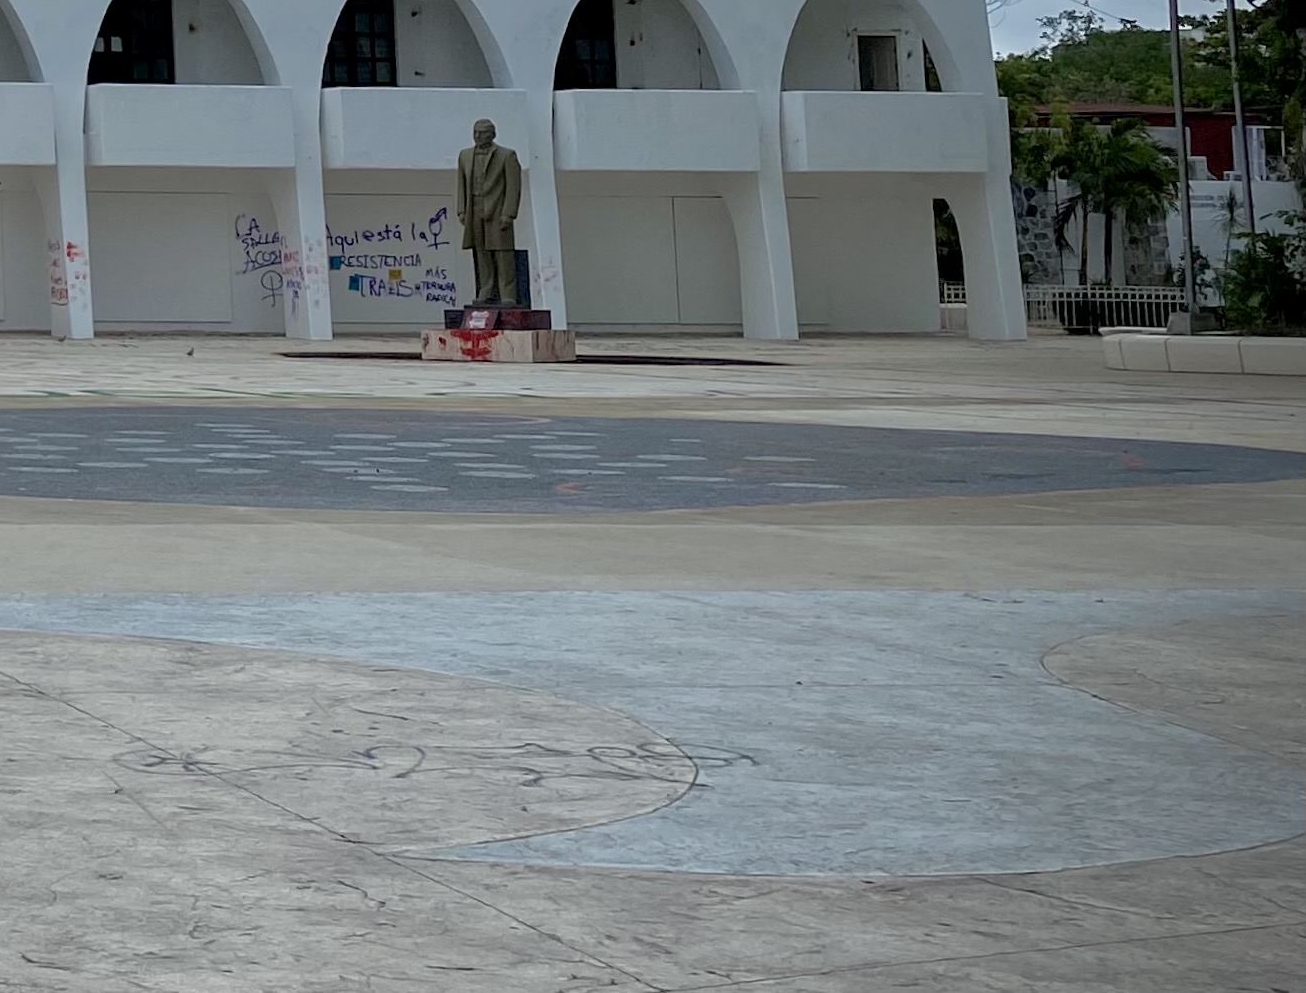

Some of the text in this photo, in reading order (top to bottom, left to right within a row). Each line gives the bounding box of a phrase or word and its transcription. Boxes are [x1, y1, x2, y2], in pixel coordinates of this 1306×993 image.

[362, 224, 402, 242] está
[411, 222, 428, 242] la
[339, 254, 422, 269] RESISTENCIA
